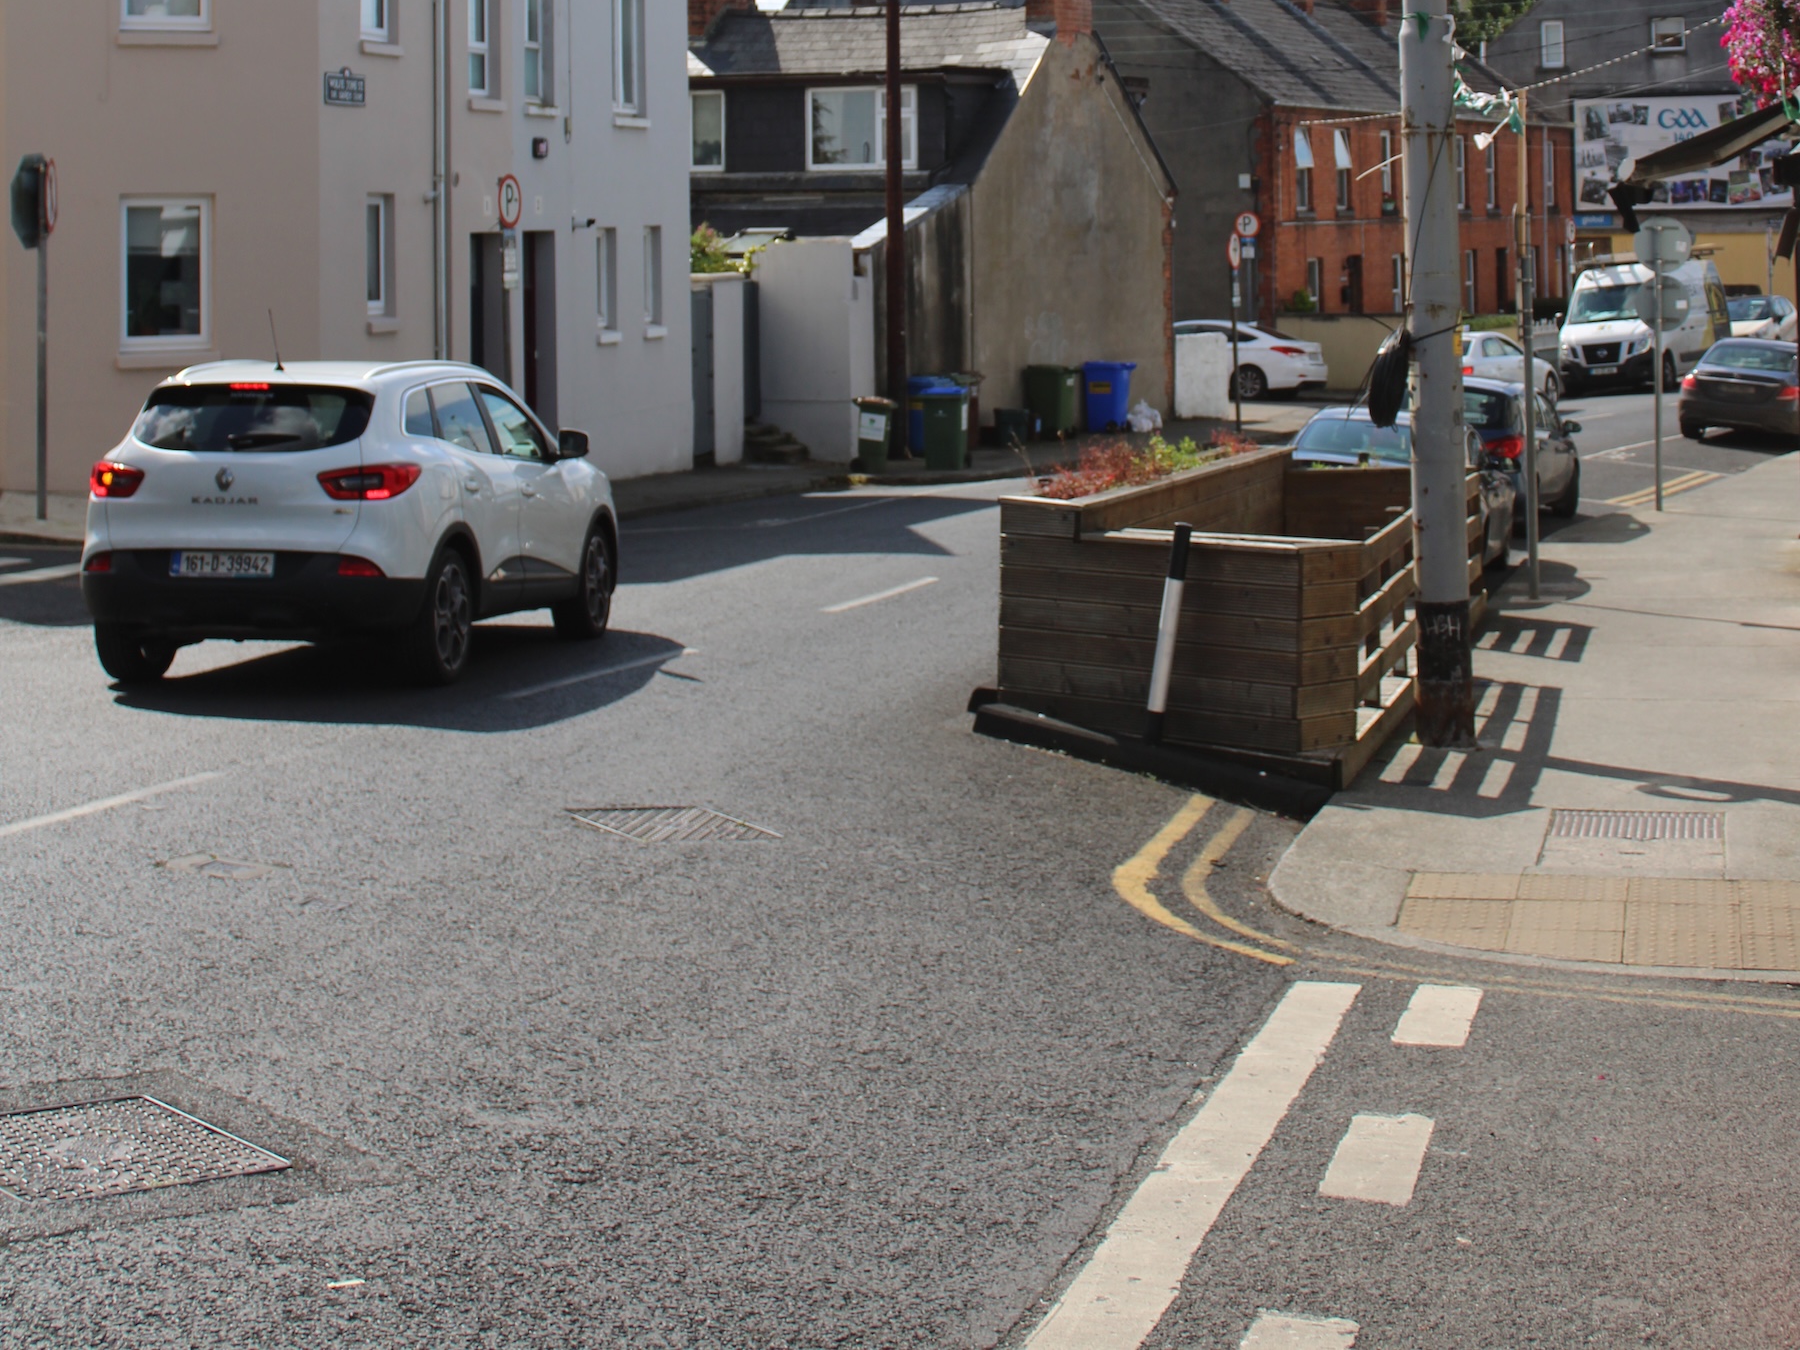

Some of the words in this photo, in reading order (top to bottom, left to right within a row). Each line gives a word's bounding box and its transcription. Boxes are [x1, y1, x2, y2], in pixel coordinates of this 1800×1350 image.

[1658, 108, 1709, 129] GAA
[191, 496, 258, 505] KADJAR
[185, 553, 270, 572] 161-D-39942
